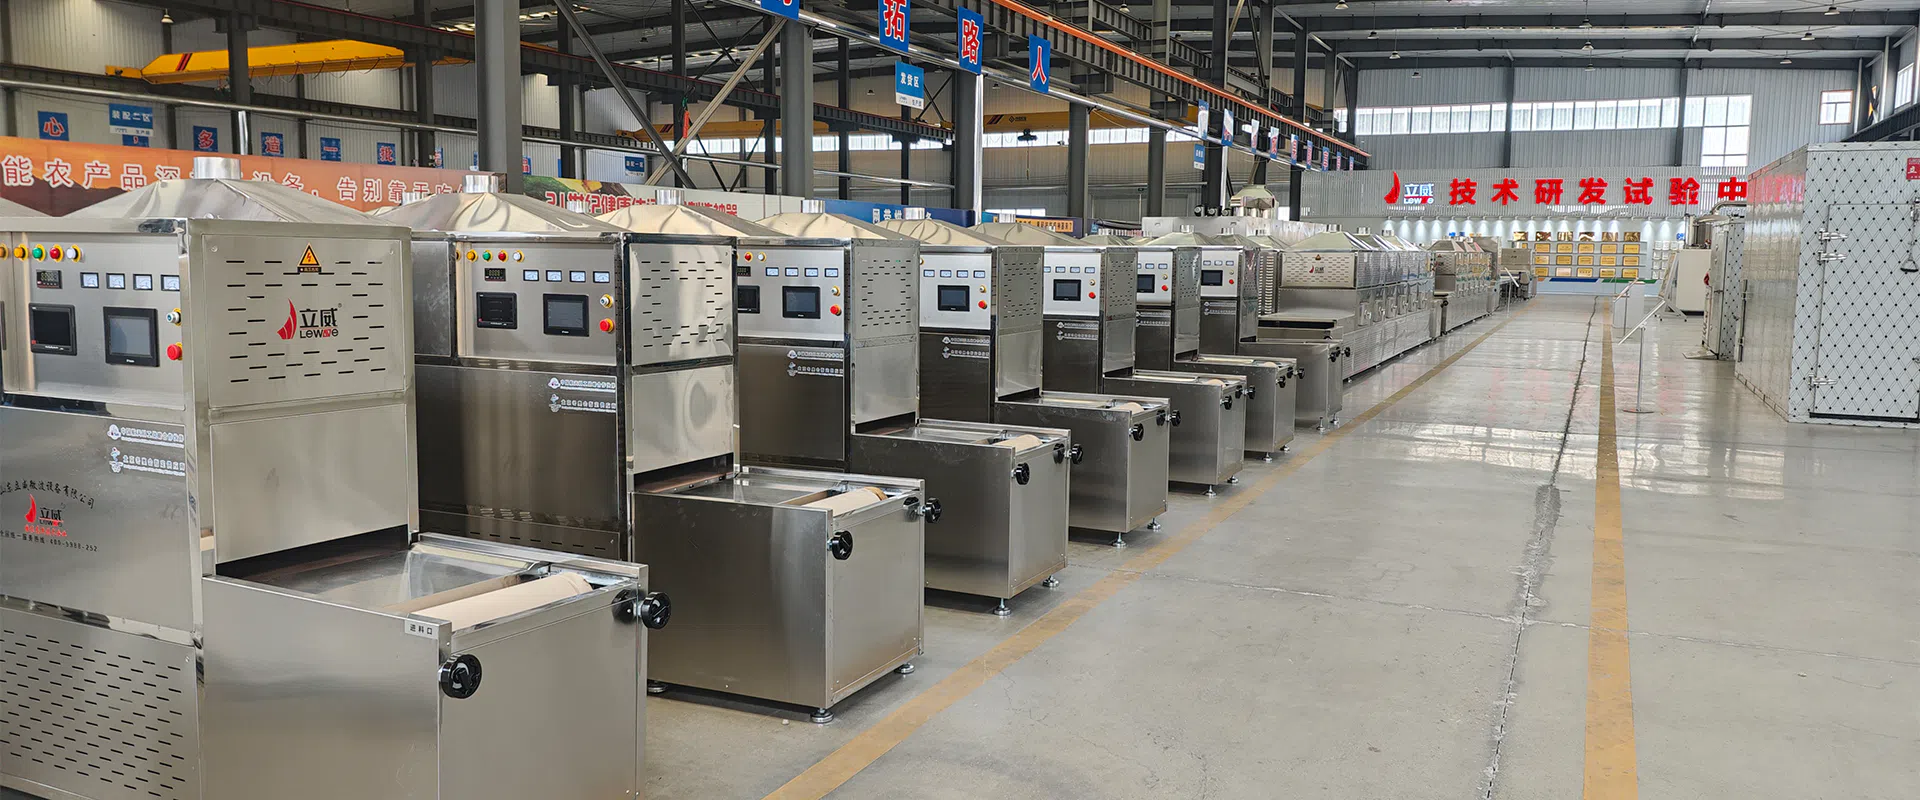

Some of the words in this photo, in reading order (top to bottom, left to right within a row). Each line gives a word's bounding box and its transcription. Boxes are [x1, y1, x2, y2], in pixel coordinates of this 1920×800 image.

[883, 0, 905, 41] 拓
[961, 18, 980, 65] 路
[1031, 46, 1047, 85] 人
[900, 71, 919, 88] 发货区
[111, 109, 152, 122] 装配二区
[43, 115, 65, 137] 心
[198, 130, 215, 150] 多
[264, 135, 281, 153] 造
[378, 147, 394, 164] 批
[1404, 183, 1434, 196] 立威
[1448, 177, 1748, 206] 技术研发试验中
[299, 307, 338, 328] 立威
[40, 507, 62, 521] 立威
